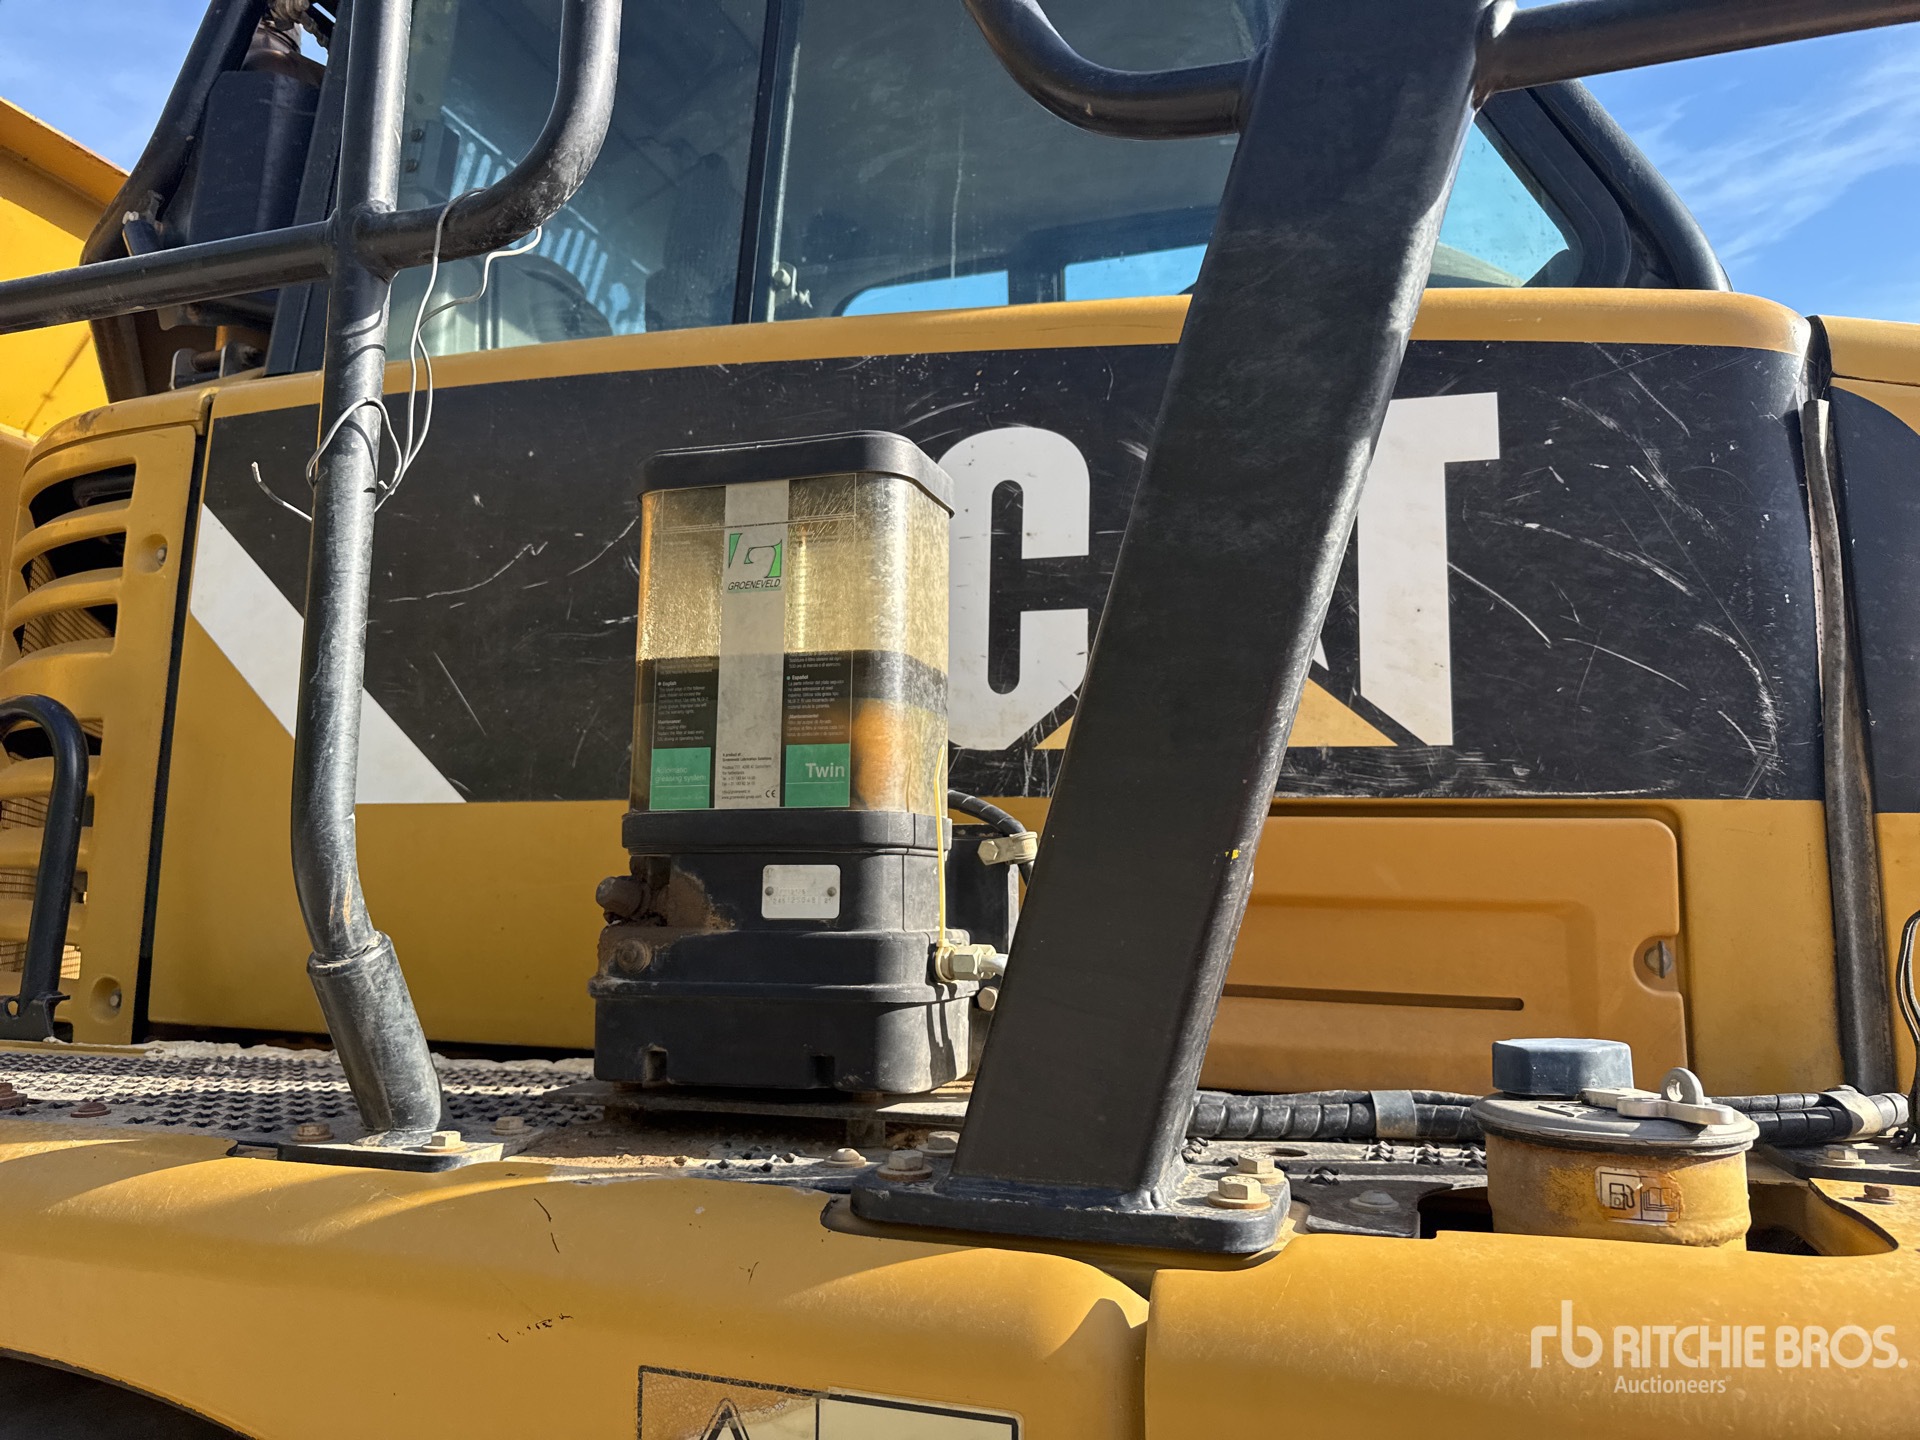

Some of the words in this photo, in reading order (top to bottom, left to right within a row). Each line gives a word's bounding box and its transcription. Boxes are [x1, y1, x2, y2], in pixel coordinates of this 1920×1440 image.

[938, 392, 1500, 750] CT
[727, 579, 781, 591] GROENEVELD
[805, 762, 845, 778] Twin
